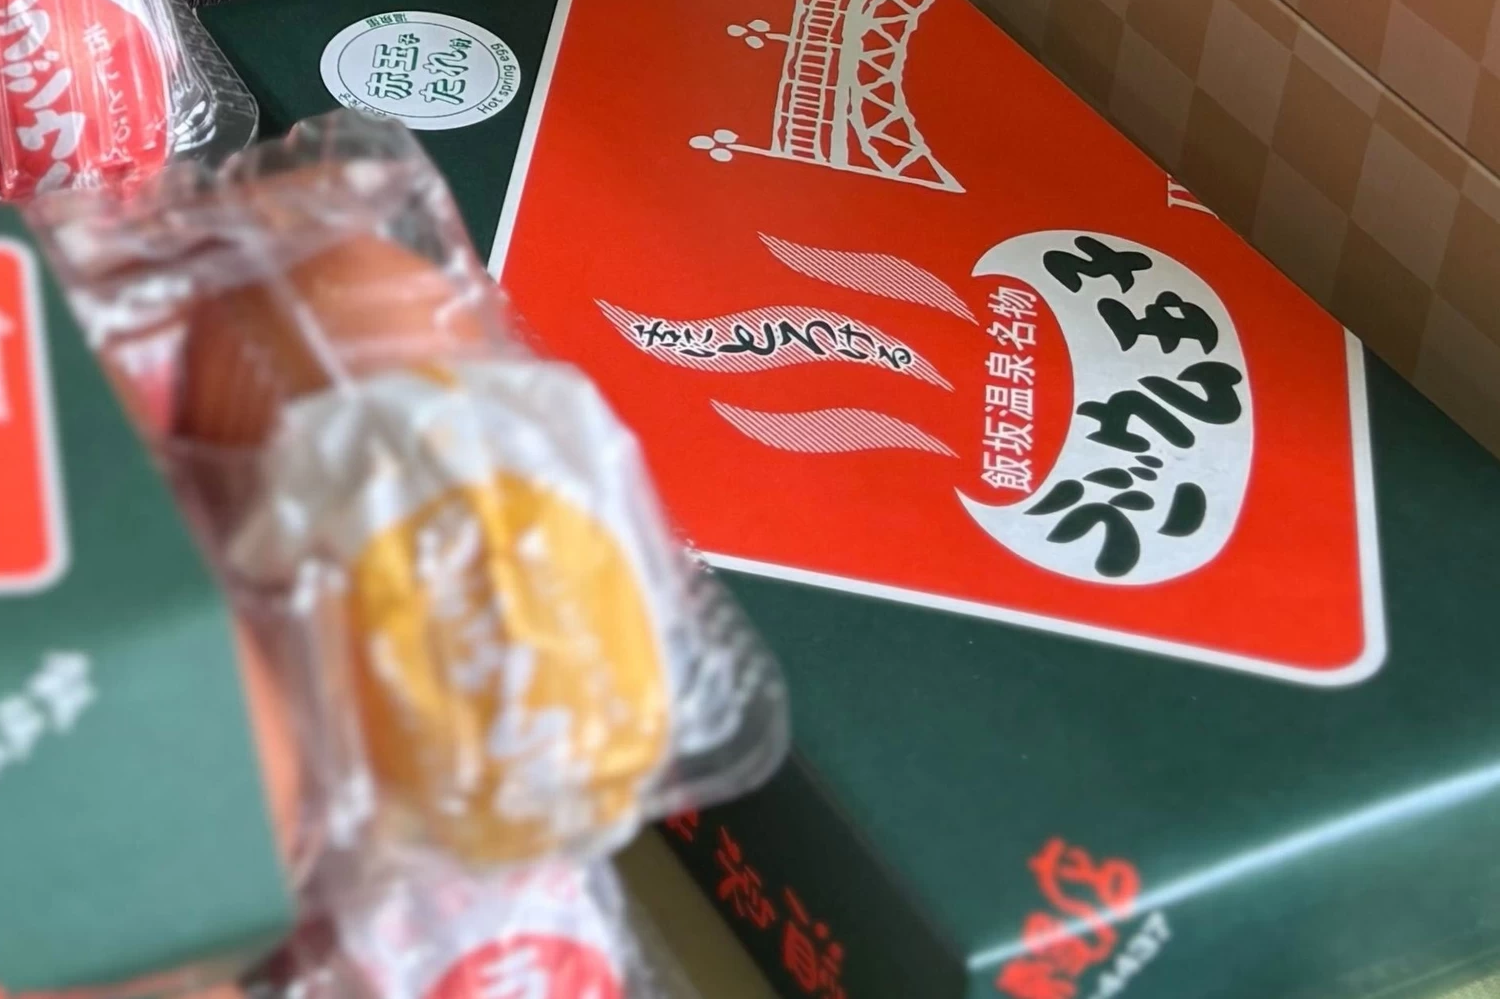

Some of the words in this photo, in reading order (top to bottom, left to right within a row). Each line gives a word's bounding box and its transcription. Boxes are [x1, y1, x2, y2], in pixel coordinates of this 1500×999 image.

[365, 33, 421, 101] 赤玉子
[489, 42, 511, 63] egg
[501, 63, 517, 97] spring
[476, 96, 503, 115] Hot
[632, 318, 916, 370] 舌にとろける
[979, 285, 1038, 495] 飯坂温泉名物
